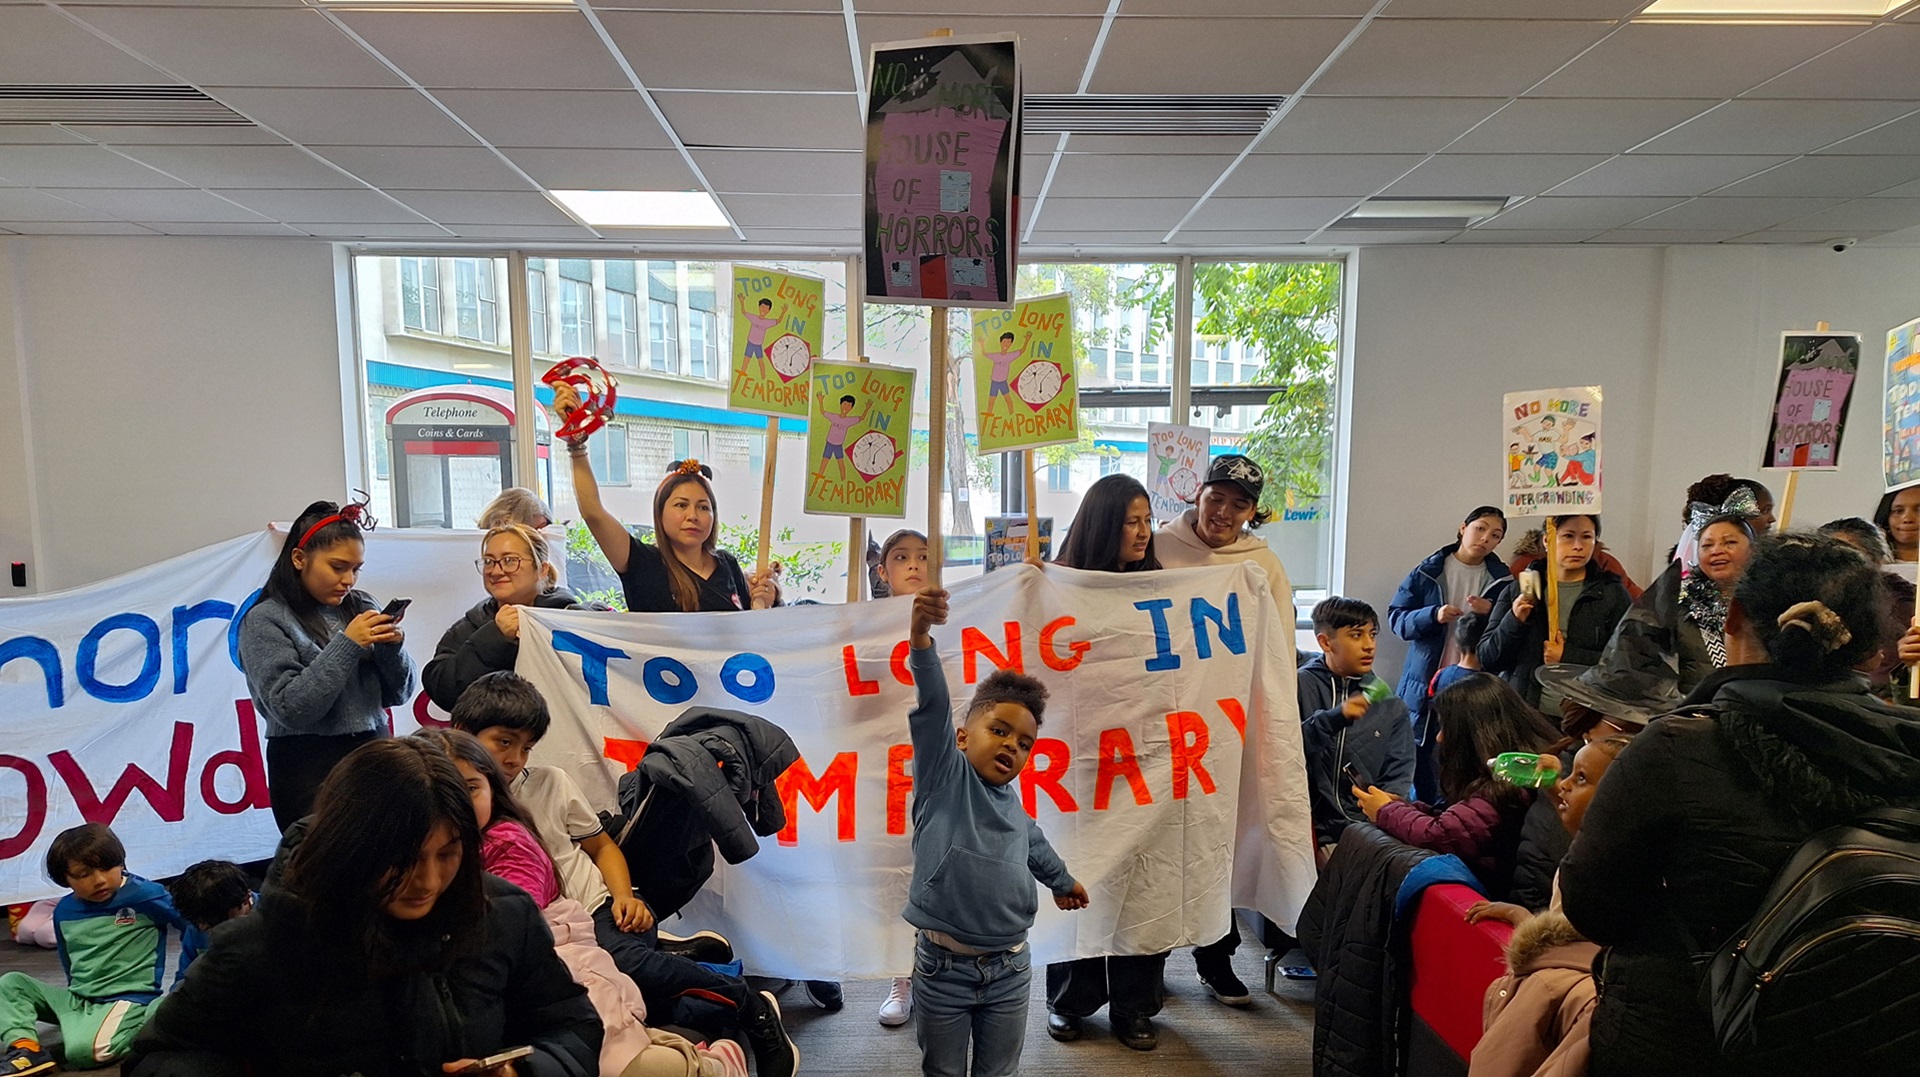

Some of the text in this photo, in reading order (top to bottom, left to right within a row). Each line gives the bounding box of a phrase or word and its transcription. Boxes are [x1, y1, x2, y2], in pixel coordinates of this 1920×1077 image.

[872, 63, 908, 96] NO
[936, 83, 1004, 121] MORE
[886, 132, 970, 166] OUSE
[893, 178, 922, 205] OF
[875, 214, 1000, 257] HORRORS
[735, 276, 818, 318] TOO LONG
[786, 314, 806, 336] IN
[976, 304, 1064, 338] TOO LONG
[1030, 340, 1053, 358] IN
[814, 370, 905, 412] TOO LONG
[423, 406, 478, 419] Telephone
[868, 410, 891, 431] IN
[980, 398, 1074, 438] TEMPORARY
[1514, 398, 1591, 421] NO MORE
[1787, 404, 1804, 417] OF
[418, 428, 484, 438] Coins & Cards
[1152, 431, 1203, 457] TOO LONG
[1181, 455, 1194, 469] IN
[808, 472, 905, 508] TEMPORARY
[1150, 491, 1191, 513] TEMPOR
[1509, 490, 1594, 506] OVERCROWDING
[989, 552, 1010, 562] TOO
[551, 630, 775, 706] TOO
[1134, 592, 1247, 672] IN
